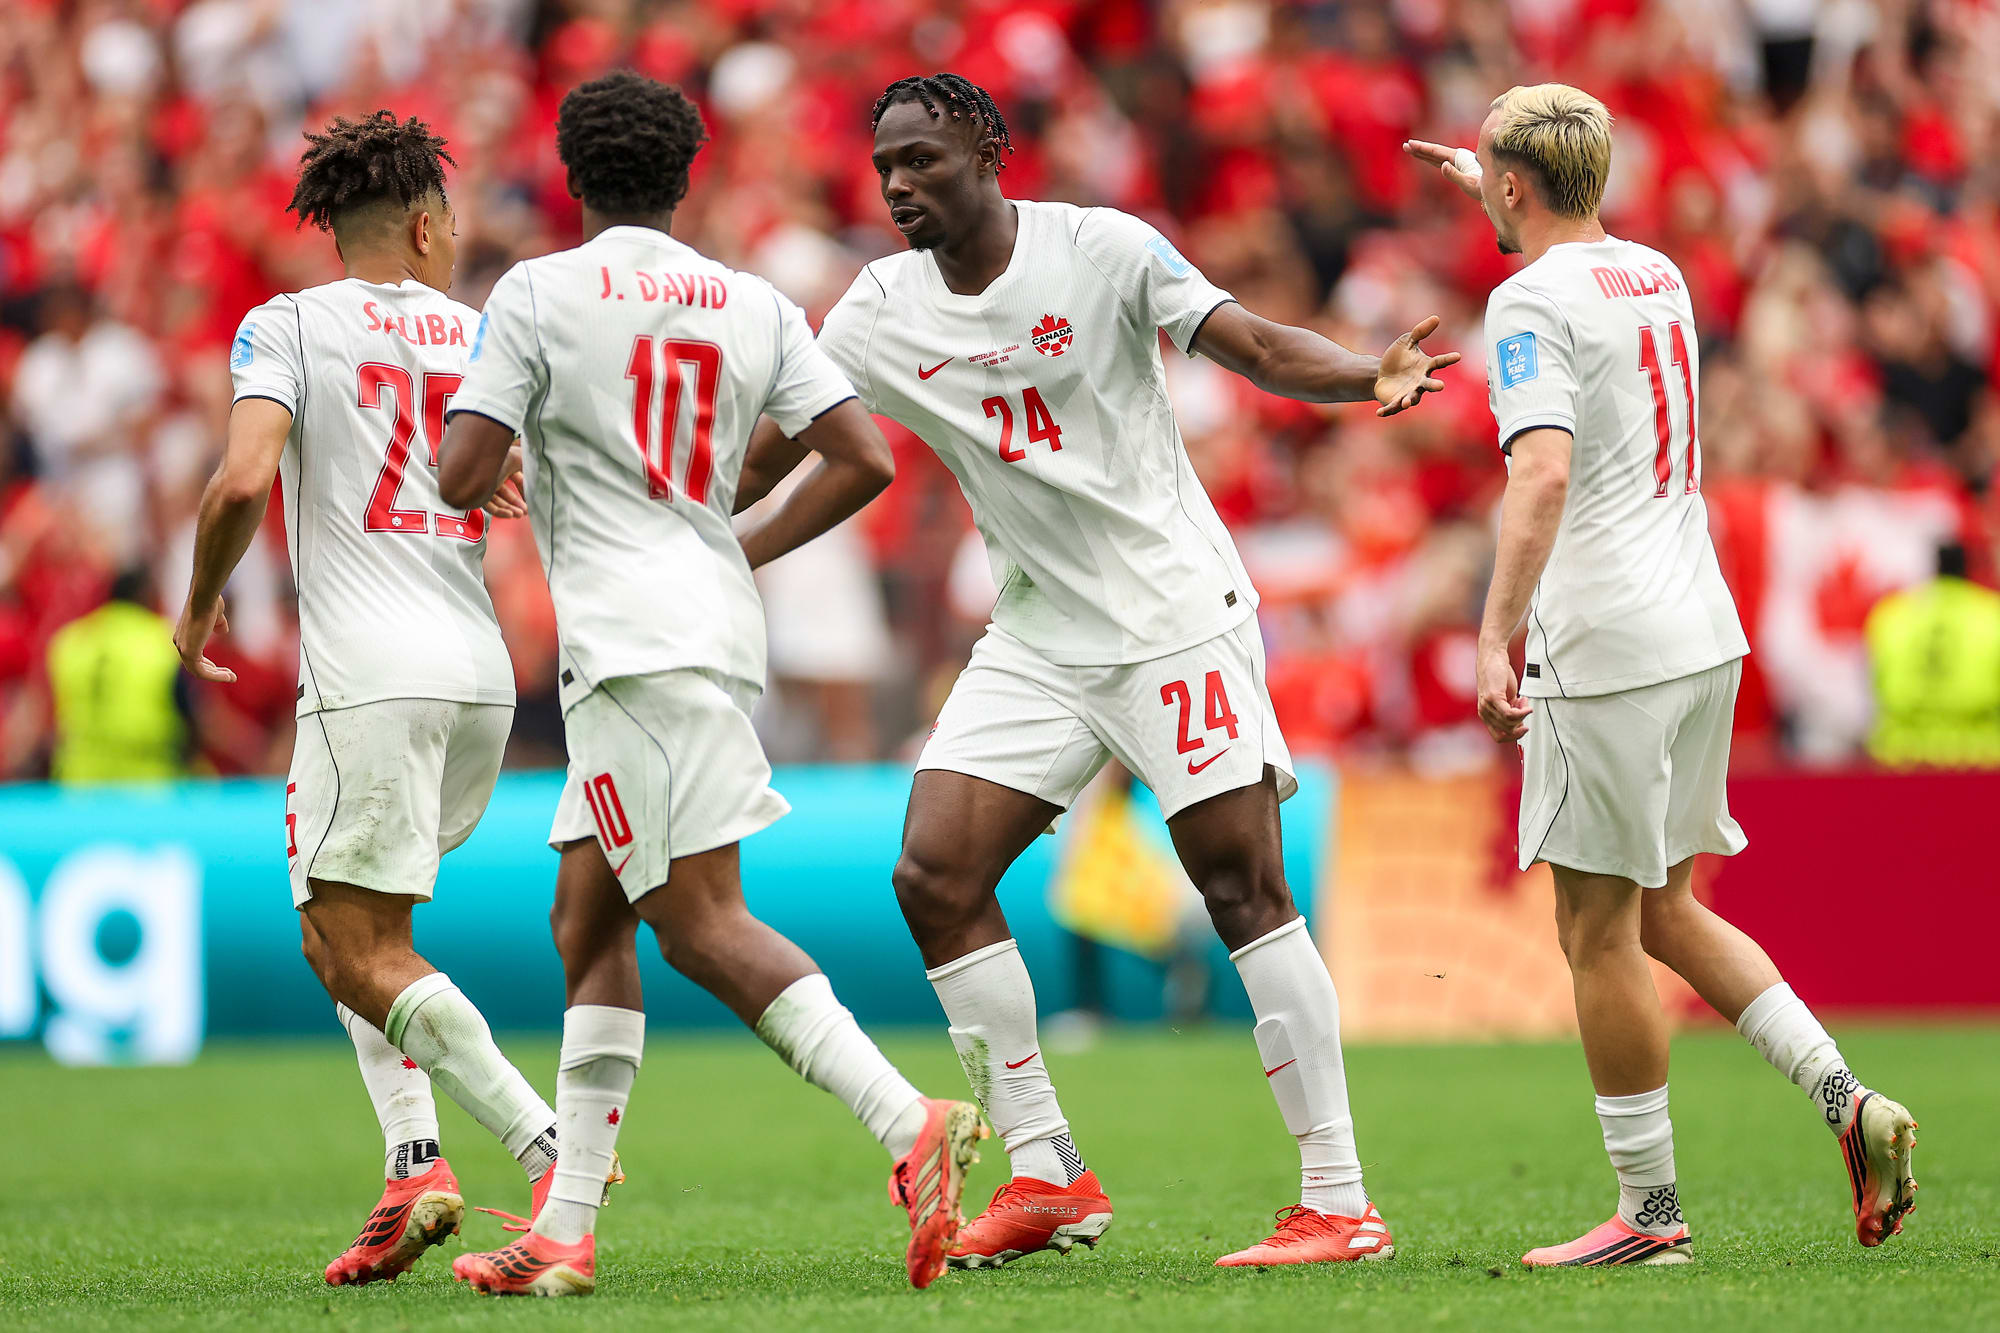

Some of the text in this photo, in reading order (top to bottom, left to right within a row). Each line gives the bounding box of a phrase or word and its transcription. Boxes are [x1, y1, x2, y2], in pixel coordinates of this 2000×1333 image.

[600, 266, 727, 310] J. DAVID
[1590, 263, 1680, 299] MILLAR
[363, 301, 468, 347] SALIBA
[1032, 326, 1073, 346] CANADA
[624, 334, 723, 507] 10
[981, 386, 1063, 463] 24
[1638, 320, 1699, 498] 11
[357, 361, 485, 543] 25
[1160, 670, 1239, 755] 24
[584, 772, 633, 852] 10
[0, 843, 205, 1067] g
[1023, 1205, 1079, 1215] NEMESIS
